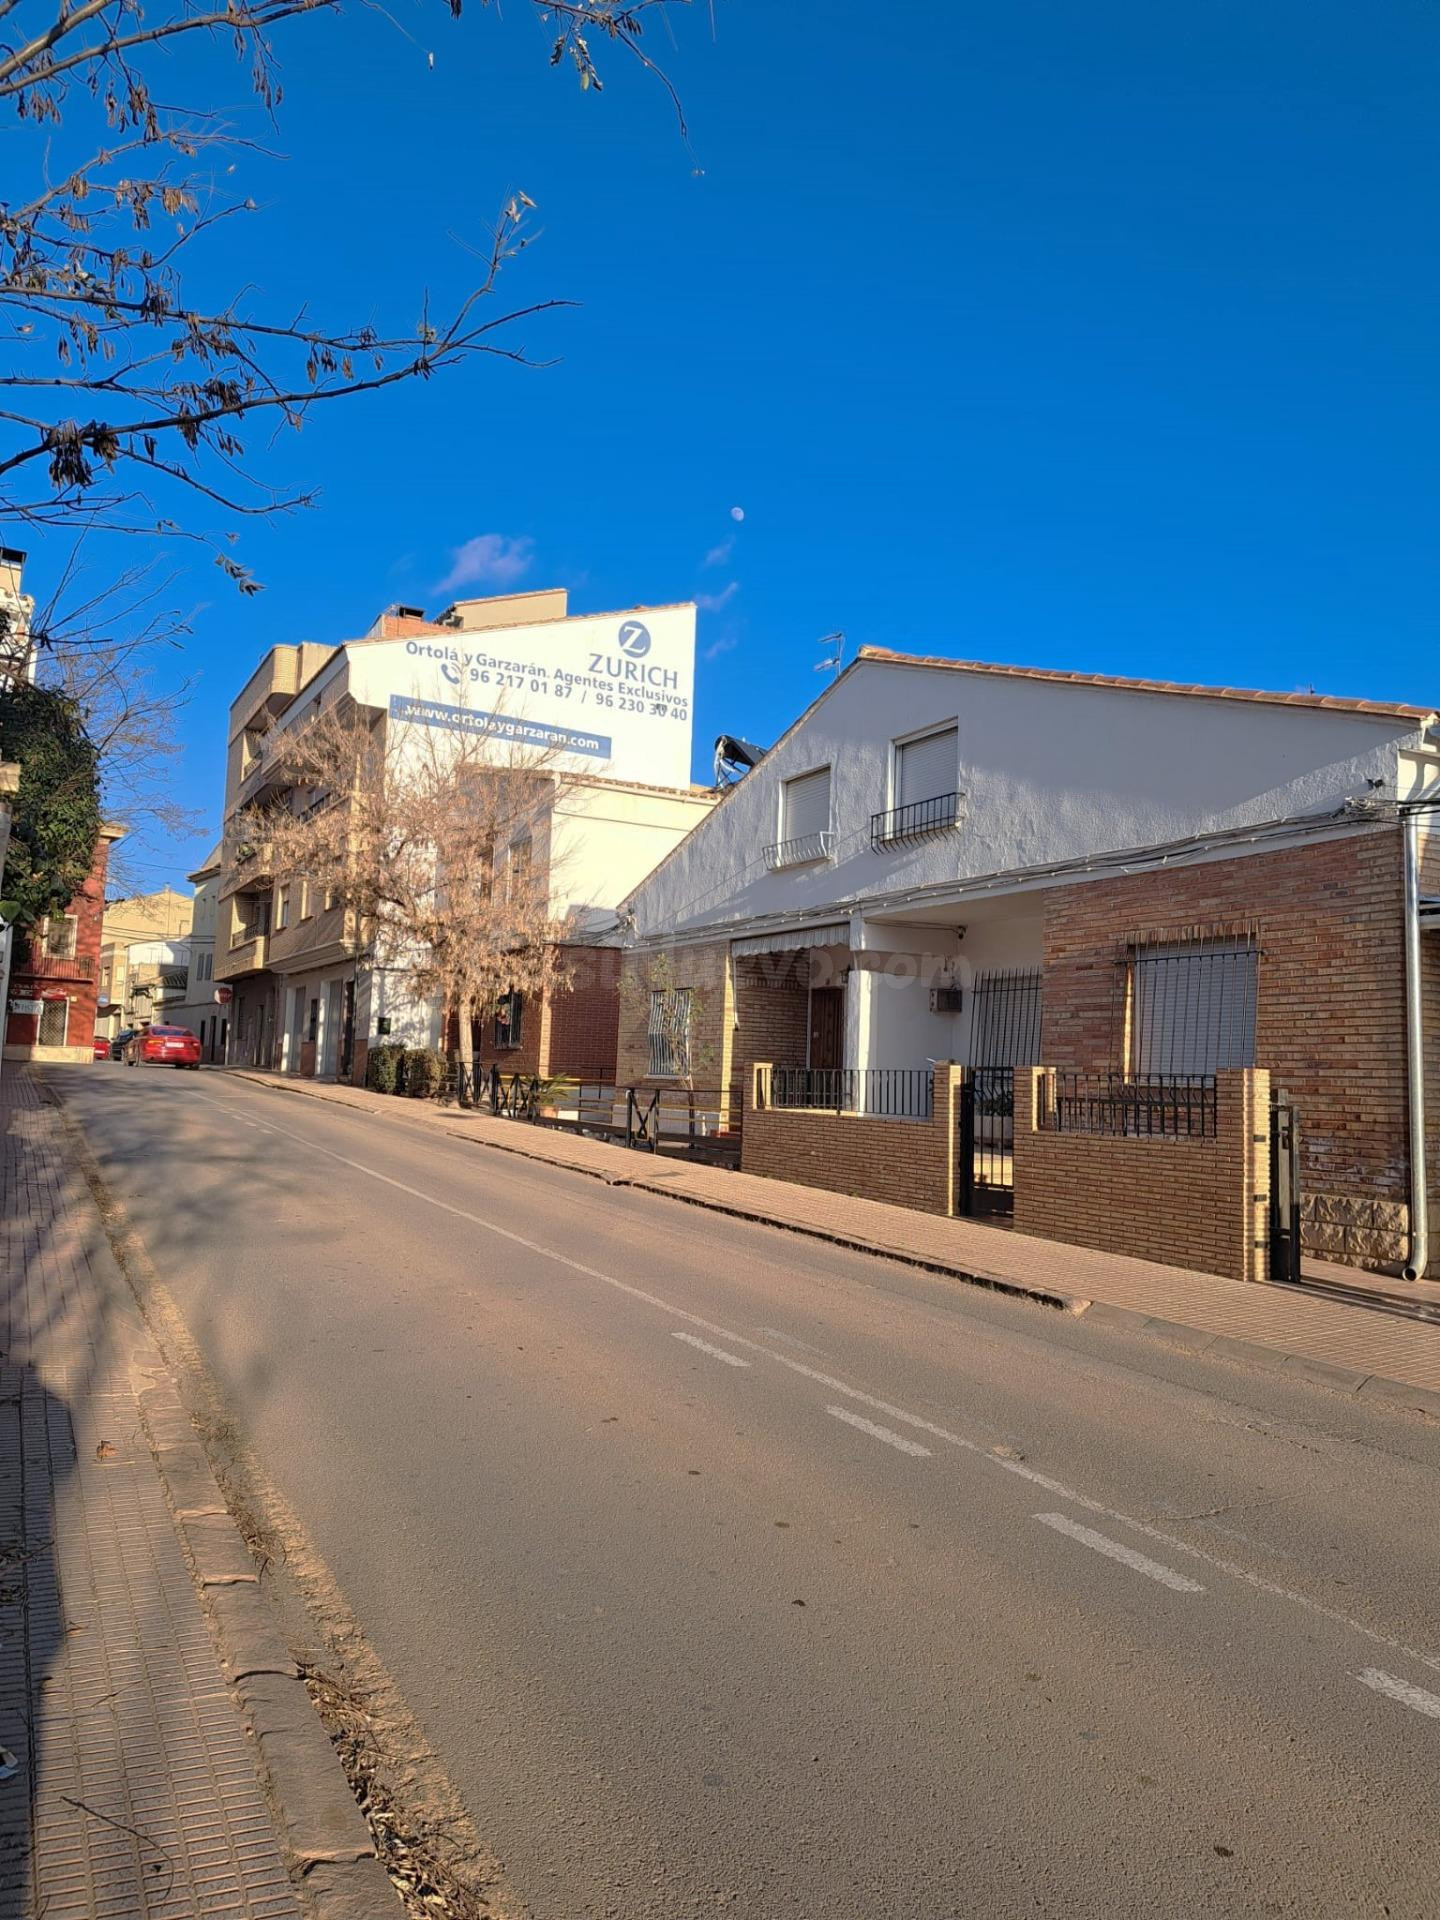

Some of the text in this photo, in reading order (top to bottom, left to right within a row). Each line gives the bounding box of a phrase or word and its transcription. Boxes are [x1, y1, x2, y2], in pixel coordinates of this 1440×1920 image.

[406, 641, 459, 662] Ortolá
[464, 653, 473, 667] y
[554, 668, 614, 692] Agentes
[618, 682, 688, 707] Exclusivos
[470, 668, 490, 683] 96
[496, 672, 524, 689] 217
[530, 679, 548, 694] 01
[554, 684, 572, 699] 87
[581, 690, 587, 704] /
[596, 693, 614, 708] 96
[618, 697, 645, 713] 230
[671, 707, 688, 721] 40
[588, 653, 678, 690] ZURICH
[404, 704, 599, 750] www.ortolaygarzaran.com
